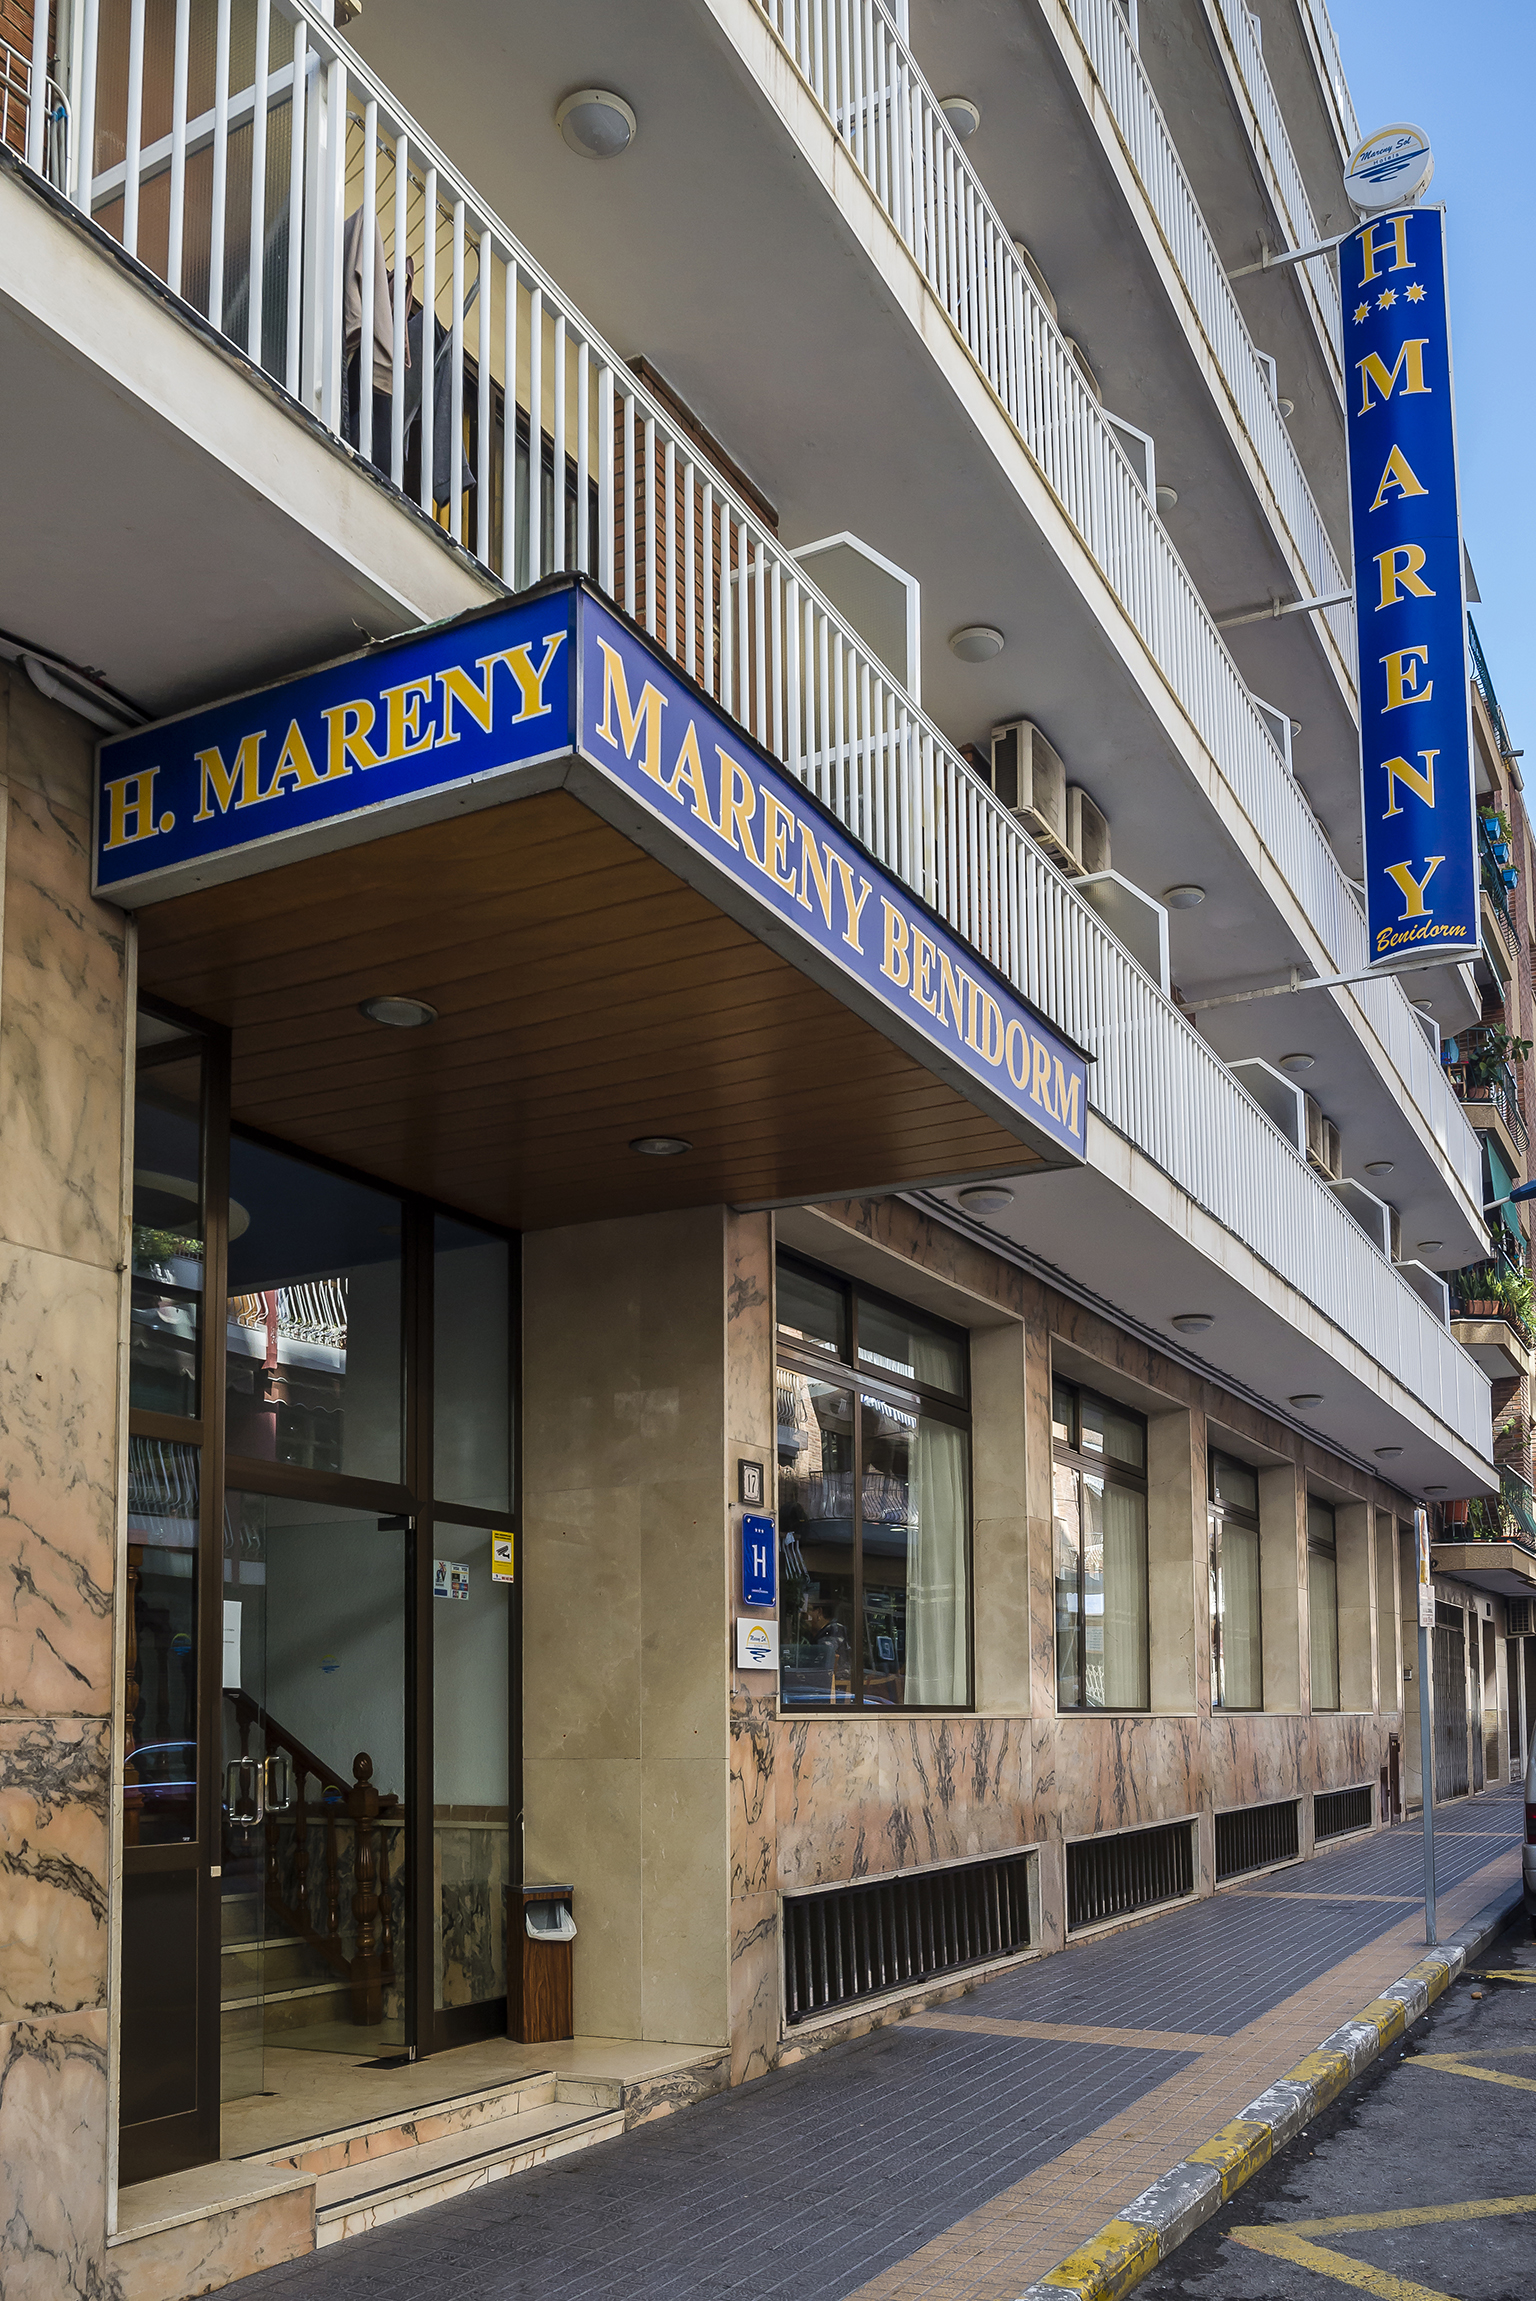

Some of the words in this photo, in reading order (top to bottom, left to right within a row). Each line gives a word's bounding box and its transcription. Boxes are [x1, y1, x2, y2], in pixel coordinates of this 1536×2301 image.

[1360, 145, 1393, 162] Mareny
[1395, 136, 1412, 149] Sol
[1373, 152, 1400, 165] Hotels
[1355, 214, 1416, 288] H
[1354, 338, 1446, 922] MARENY
[102, 766, 176, 852] H.
[193, 629, 568, 824] MARENY
[595, 635, 873, 956] MARENY
[879, 894, 1082, 1140] BENIDORM
[1376, 919, 1468, 952] Benidorm
[747, 1473, 757, 1494] 17
[751, 1544, 767, 1578] H
